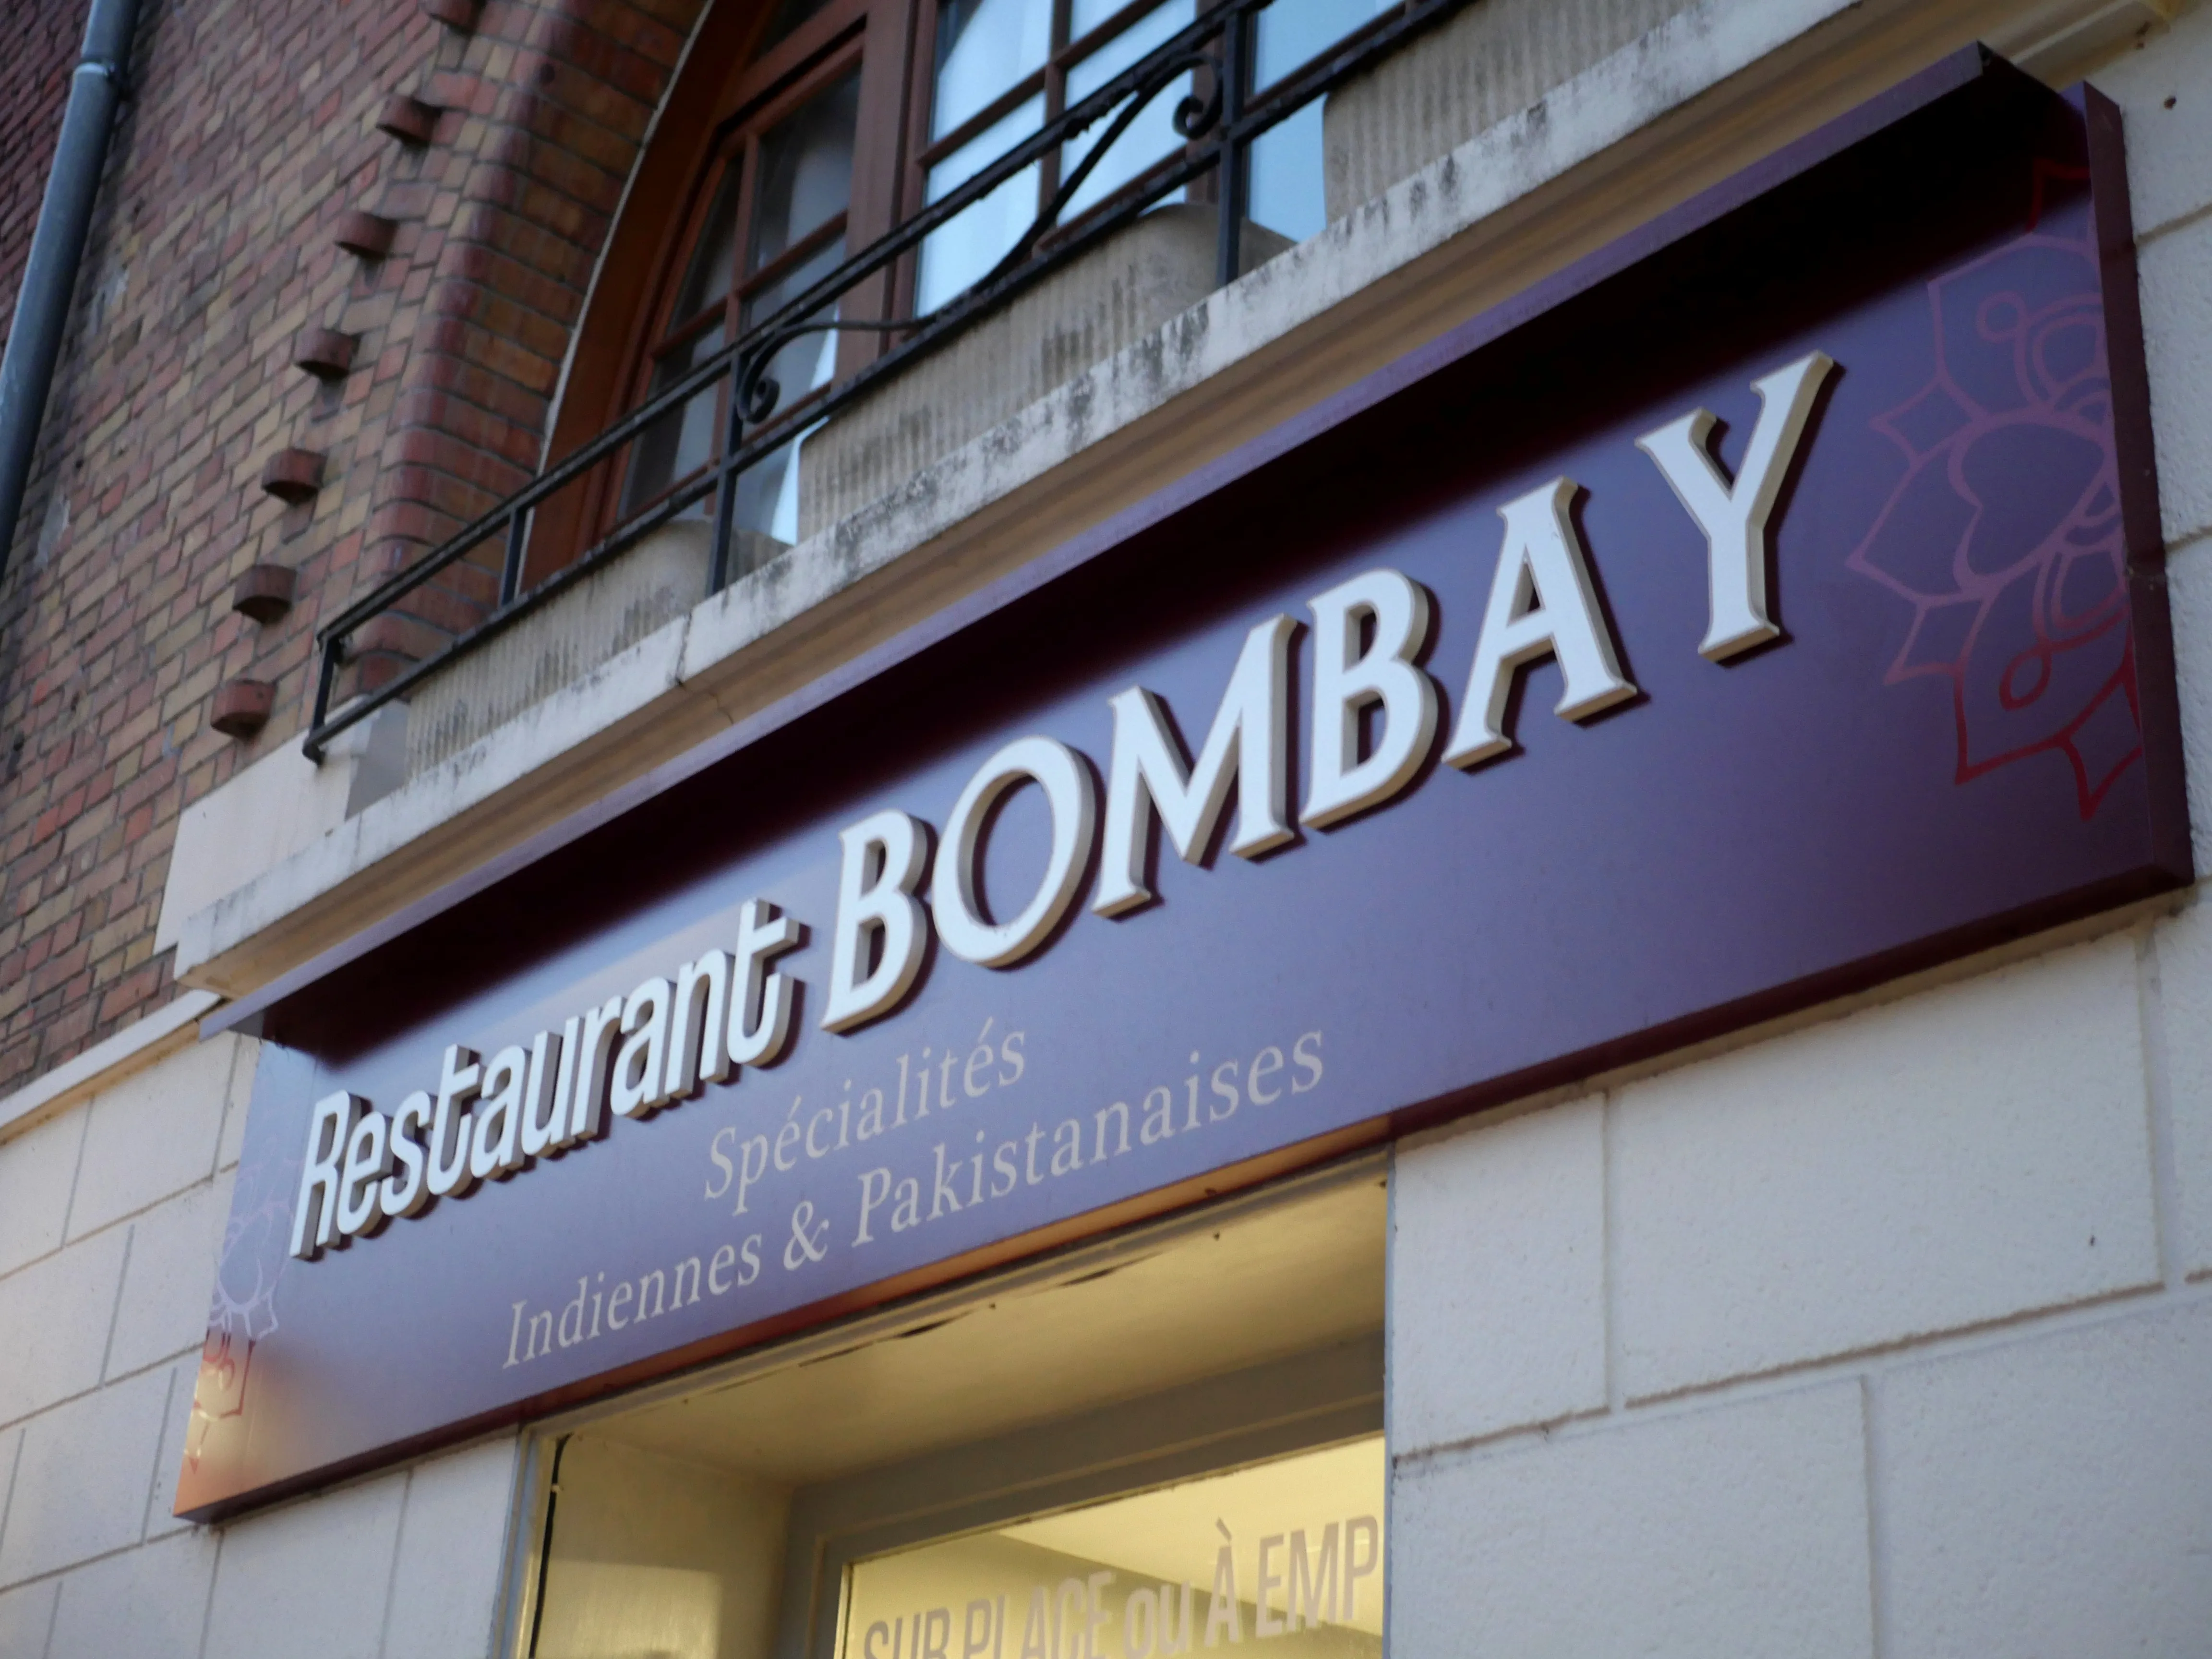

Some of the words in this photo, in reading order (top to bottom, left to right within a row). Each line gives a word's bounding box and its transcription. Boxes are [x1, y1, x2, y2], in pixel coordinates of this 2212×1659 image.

[291, 897, 809, 1262] Restaurant
[822, 349, 1841, 1034] BOMBAY
[502, 1226, 762, 1370] Indiennes
[782, 1200, 829, 1271] &
[851, 1029, 1325, 1247] Pakistanaises
[703, 1016, 1027, 1216] Spécialités
[1204, 1517, 1240, 1647] À
